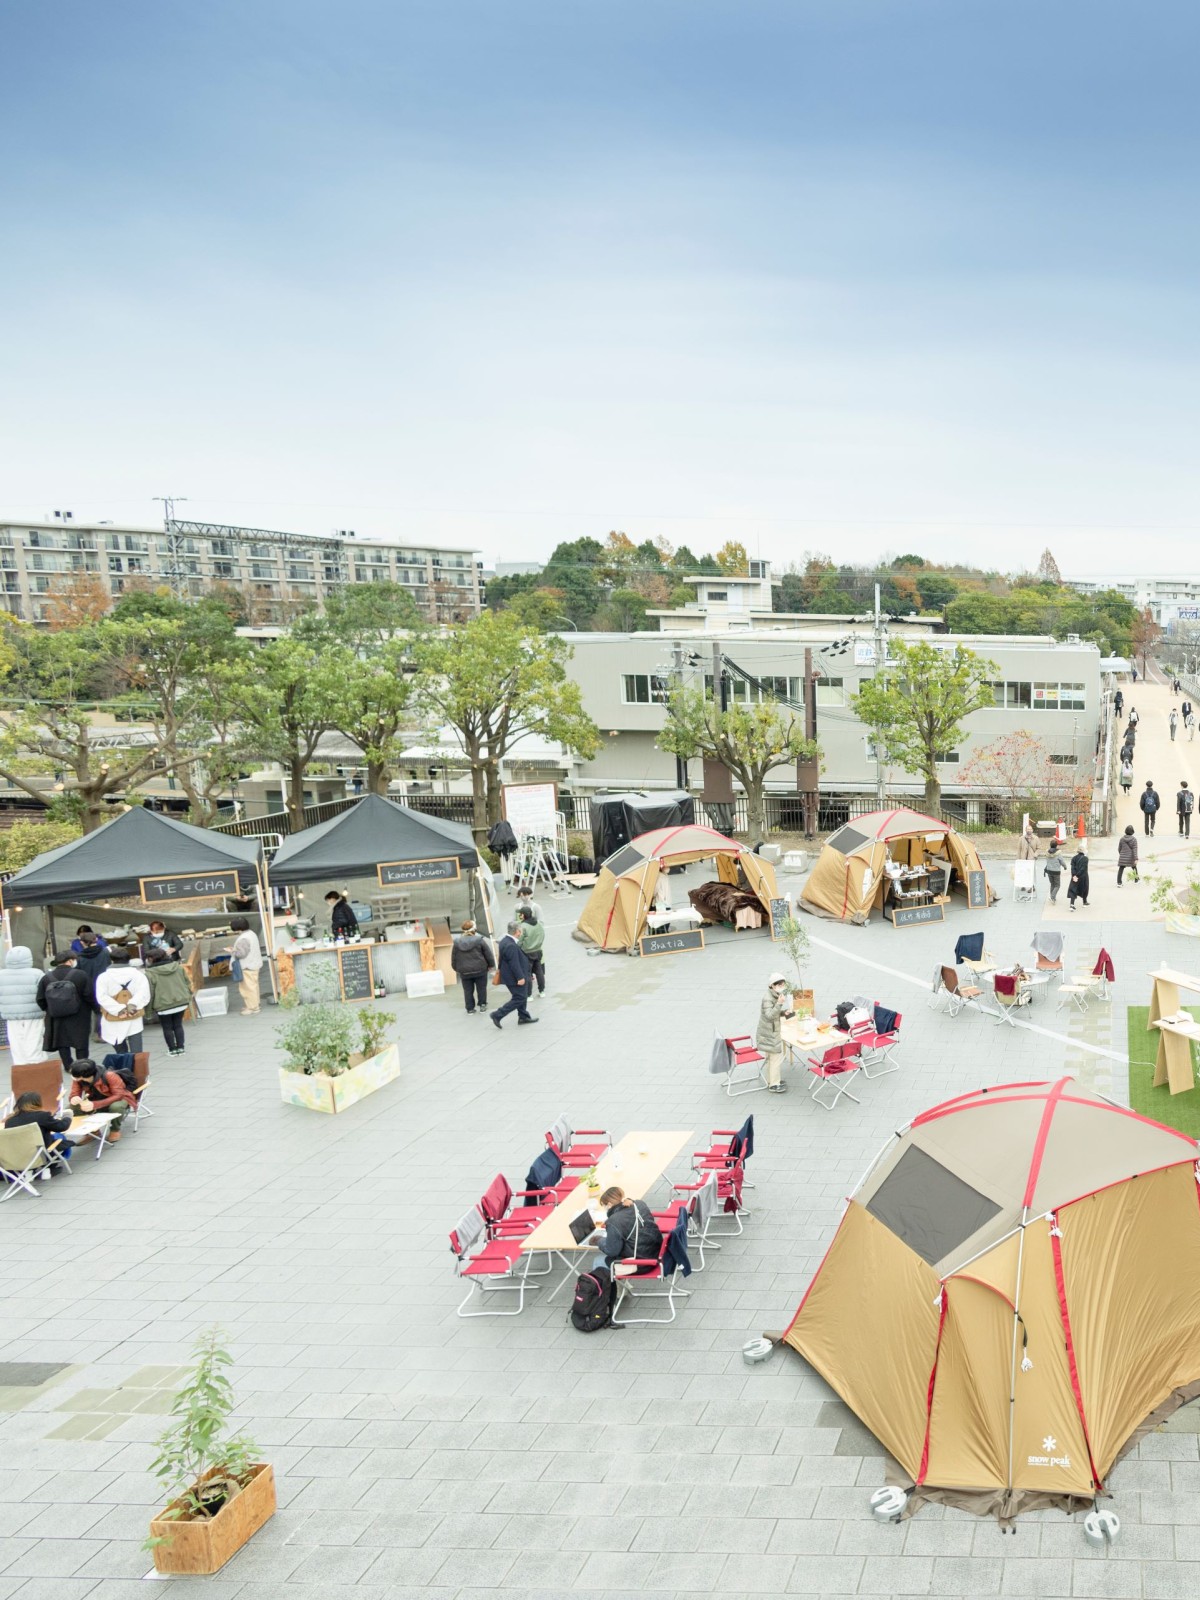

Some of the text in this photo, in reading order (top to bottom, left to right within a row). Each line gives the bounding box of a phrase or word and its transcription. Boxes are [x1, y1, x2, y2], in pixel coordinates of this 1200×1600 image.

[154, 883, 177, 895] TE
[194, 880, 225, 892] CHA
[1027, 1455, 1049, 1463] snow
[1050, 1455, 1070, 1467] peak
